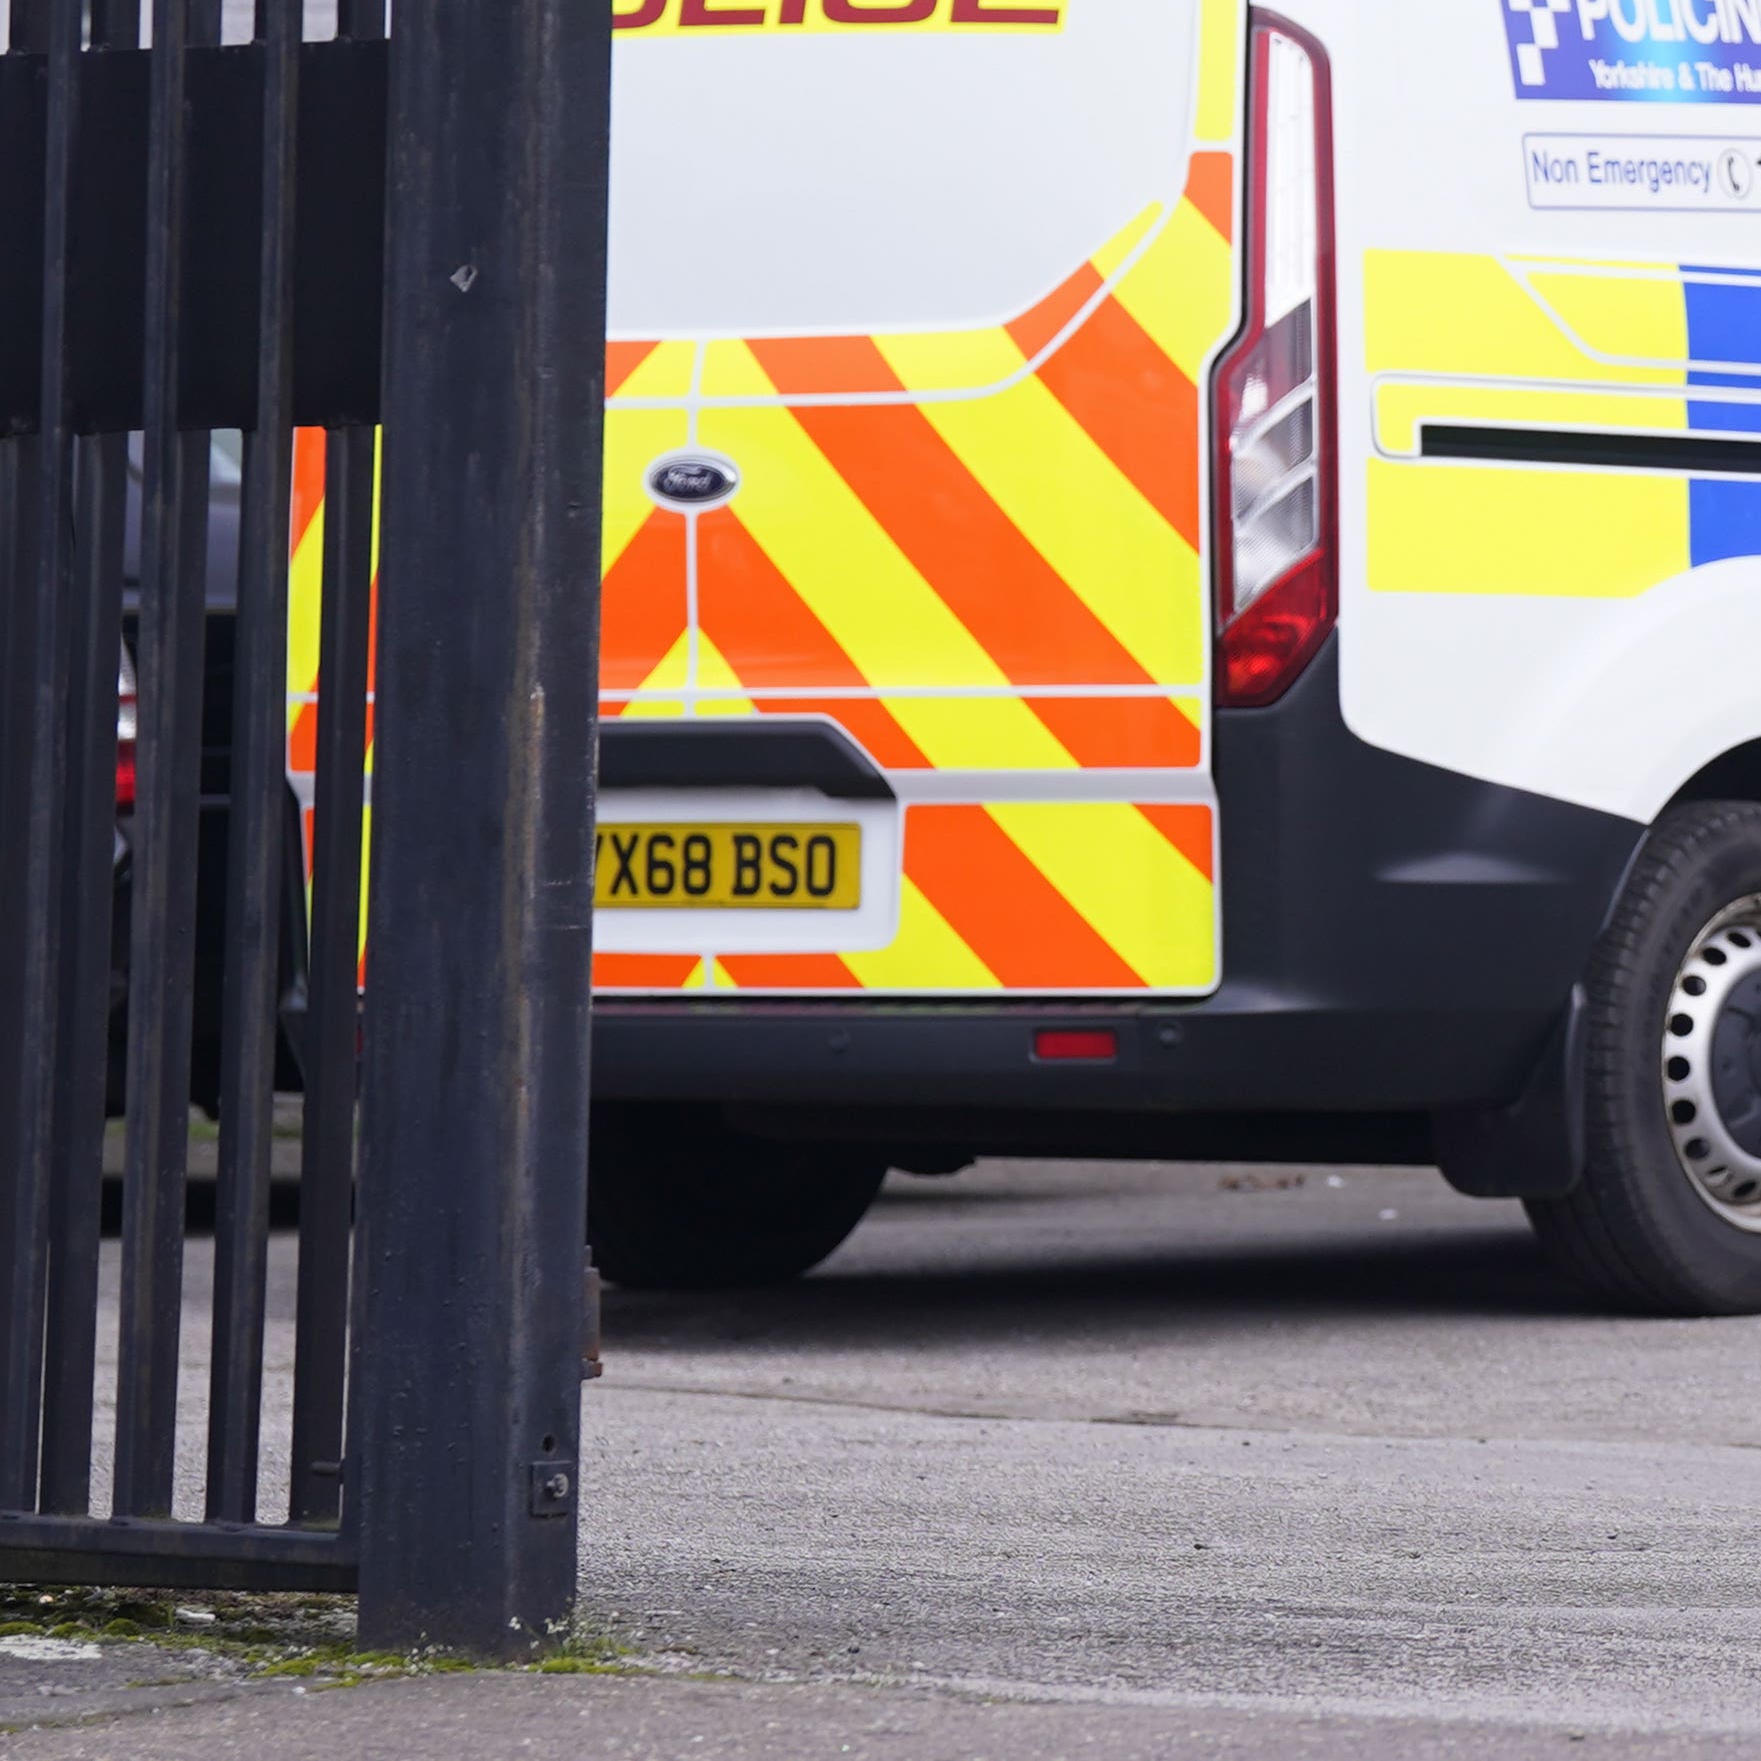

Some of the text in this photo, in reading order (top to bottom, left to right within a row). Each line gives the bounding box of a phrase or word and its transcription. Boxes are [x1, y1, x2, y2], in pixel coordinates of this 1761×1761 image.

[1588, 59, 1675, 90] Yorkshire
[1677, 61, 1696, 91] &
[1695, 61, 1733, 92] The
[1532, 150, 1579, 184] Non
[1587, 151, 1712, 193] Emergency
[732, 834, 837, 896] BSO
